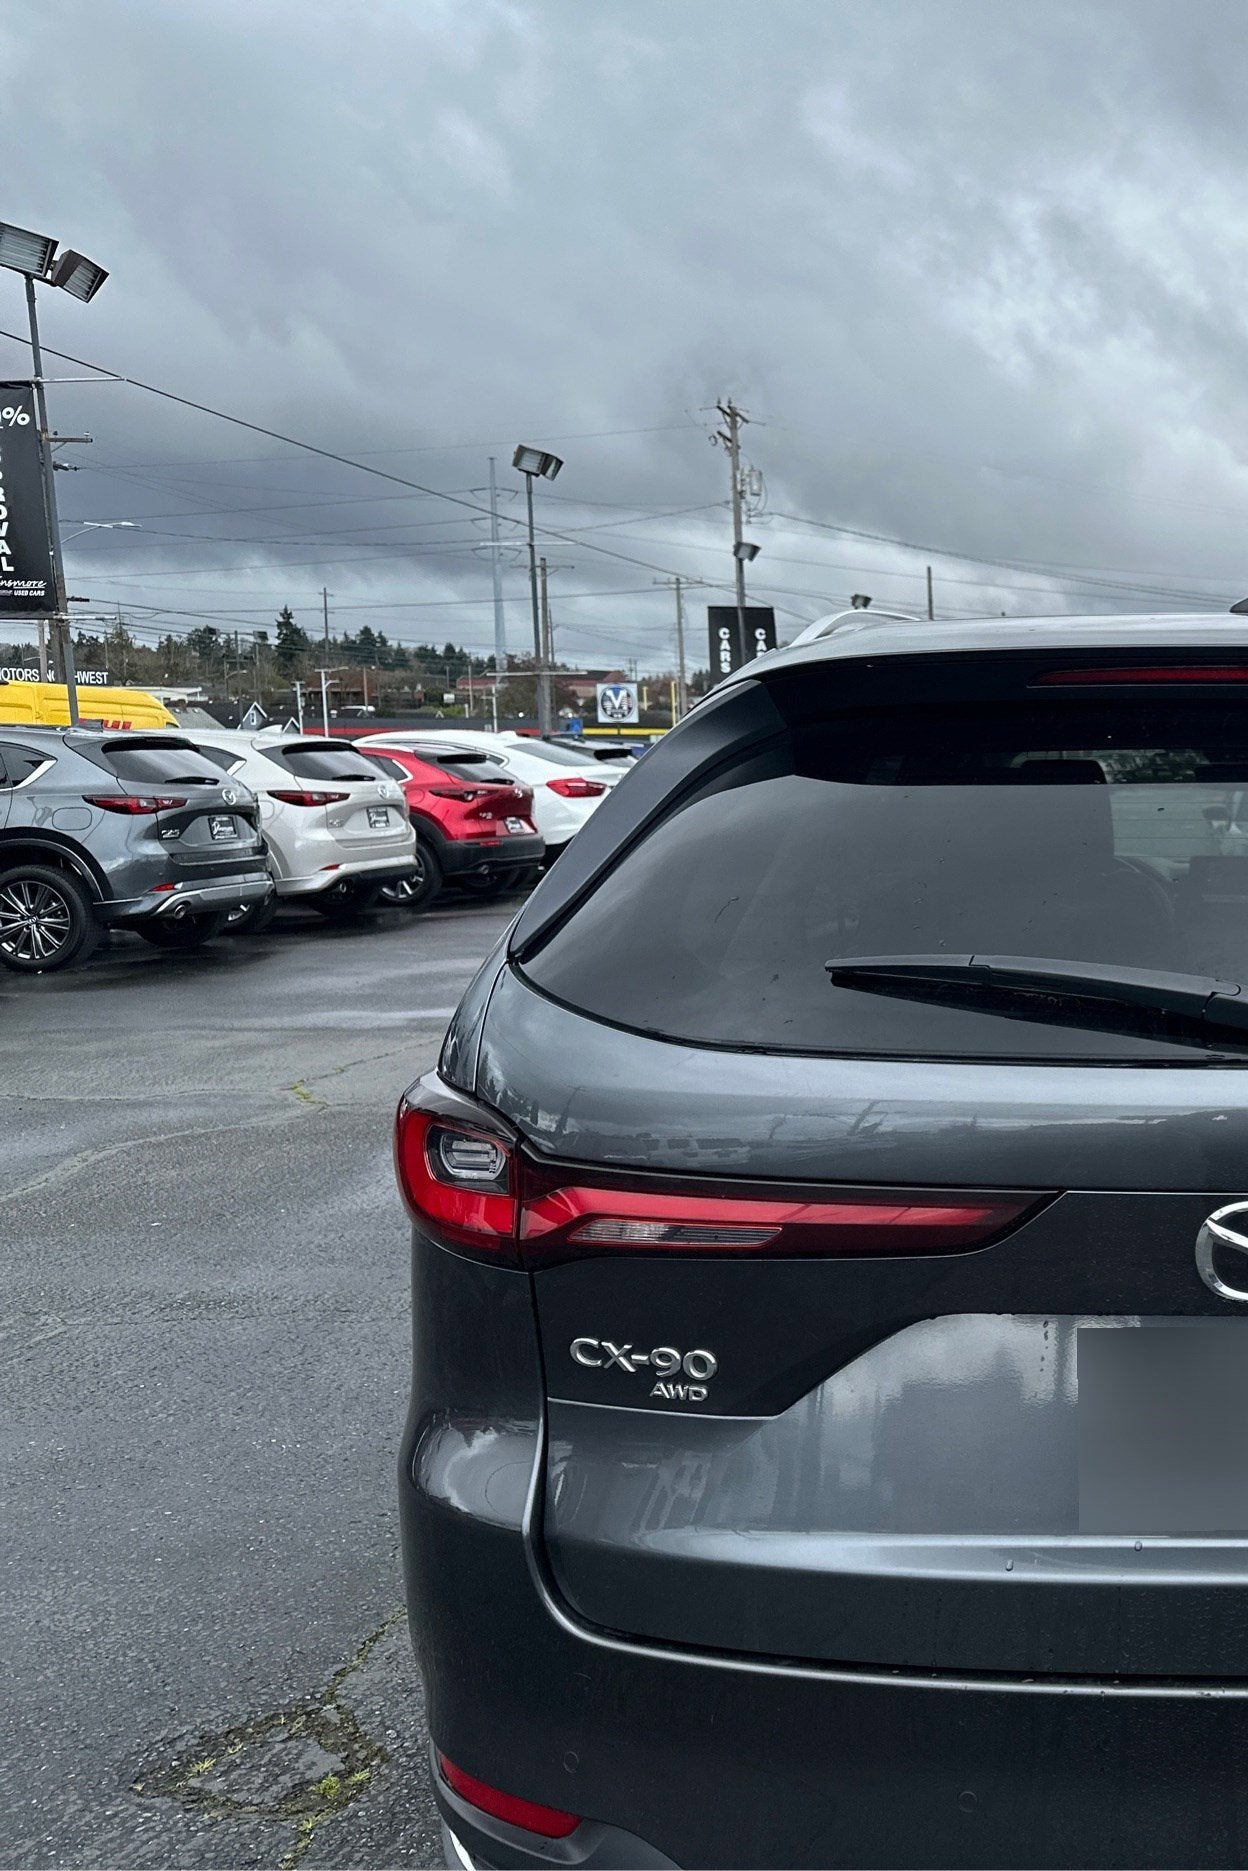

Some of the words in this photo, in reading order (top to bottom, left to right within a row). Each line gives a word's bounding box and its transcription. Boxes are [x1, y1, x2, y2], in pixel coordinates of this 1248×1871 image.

[13, 589, 29, 597] USED
[29, 589, 45, 597] CARS
[718, 627, 731, 673] CARS
[0, 667, 40, 682] OTORS
[569, 1337, 719, 1381] CX-90
[649, 1382, 709, 1402] AWD
